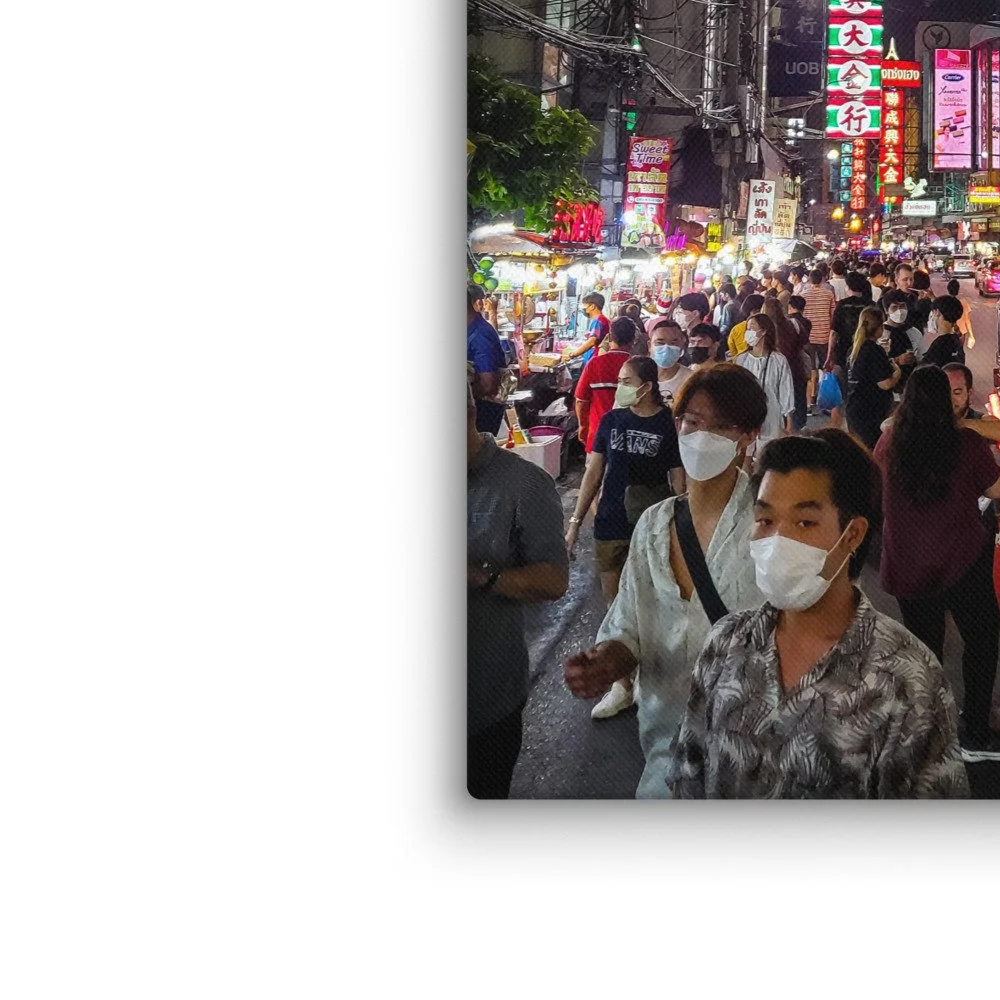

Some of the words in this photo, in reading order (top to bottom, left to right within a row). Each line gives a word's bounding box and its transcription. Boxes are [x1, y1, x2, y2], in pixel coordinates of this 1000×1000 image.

[785, 61, 819, 75] UOB
[633, 143, 668, 154] Sweet
[882, 91, 899, 203] 聯成興大金
[636, 153, 664, 164] Time
[610, 428, 664, 457] VANS
